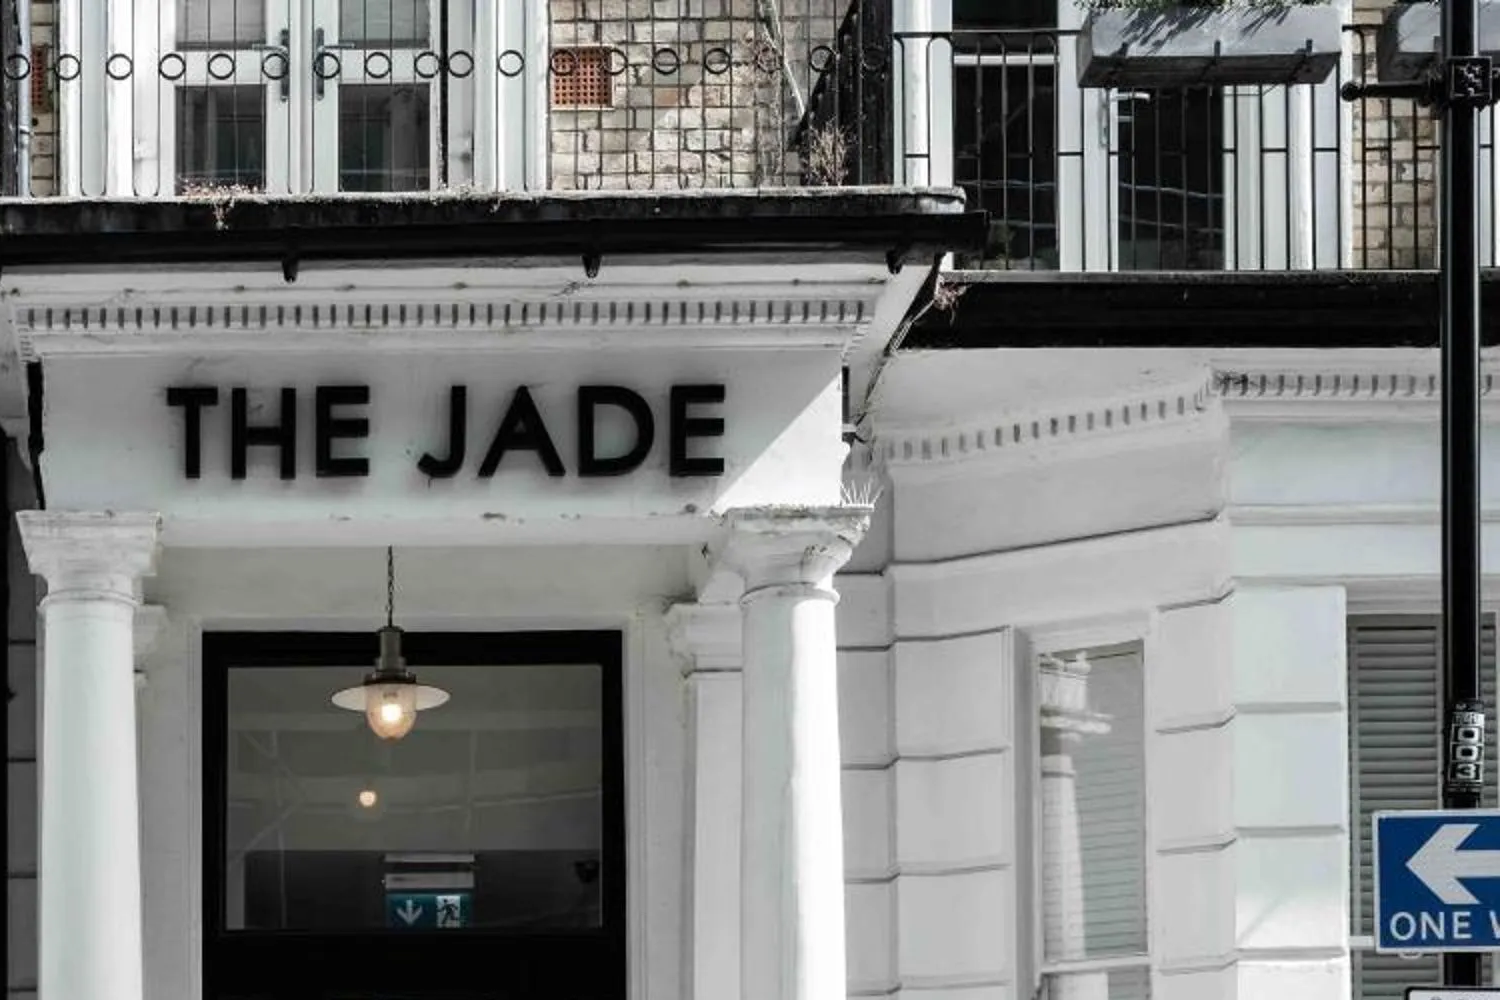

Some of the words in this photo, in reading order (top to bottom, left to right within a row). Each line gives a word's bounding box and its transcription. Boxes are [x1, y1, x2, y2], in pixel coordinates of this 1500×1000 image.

[167, 386, 369, 480] THE
[417, 385, 725, 478] JADE
[1389, 911, 1473, 941] ONE
